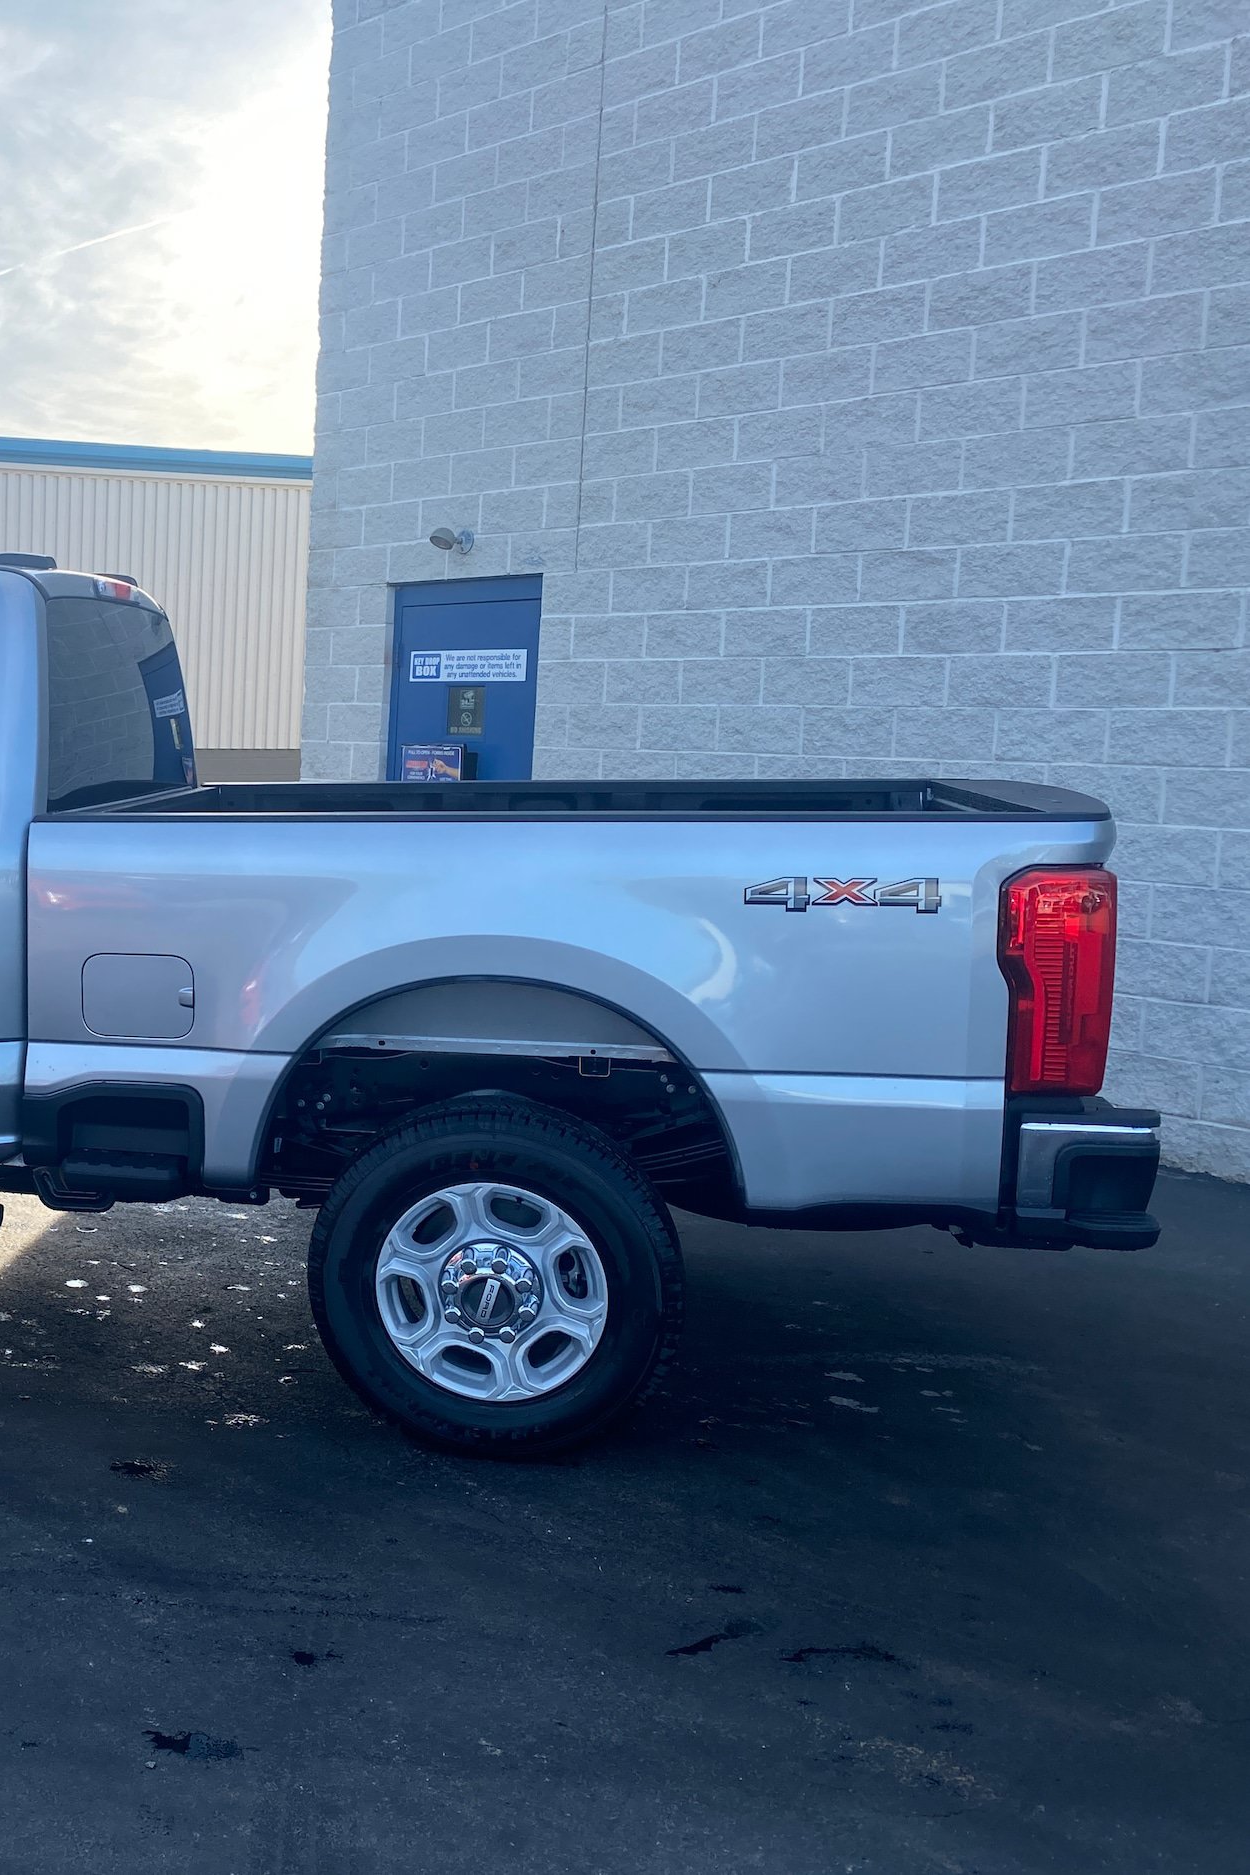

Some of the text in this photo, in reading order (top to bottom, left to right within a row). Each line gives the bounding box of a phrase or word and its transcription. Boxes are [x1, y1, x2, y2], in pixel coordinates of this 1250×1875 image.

[445, 653, 455, 661] We
[467, 653, 476, 661] not
[477, 652, 510, 663] responsible
[512, 652, 521, 661] for
[415, 665, 437, 676] BOX
[444, 663, 454, 671] any
[456, 662, 478, 671] damage
[487, 662, 503, 670] items
[504, 661, 515, 669] left
[516, 661, 522, 669] in
[446, 669, 517, 679] any unattended vehicles.
[480, 1284, 495, 1318] FORD
